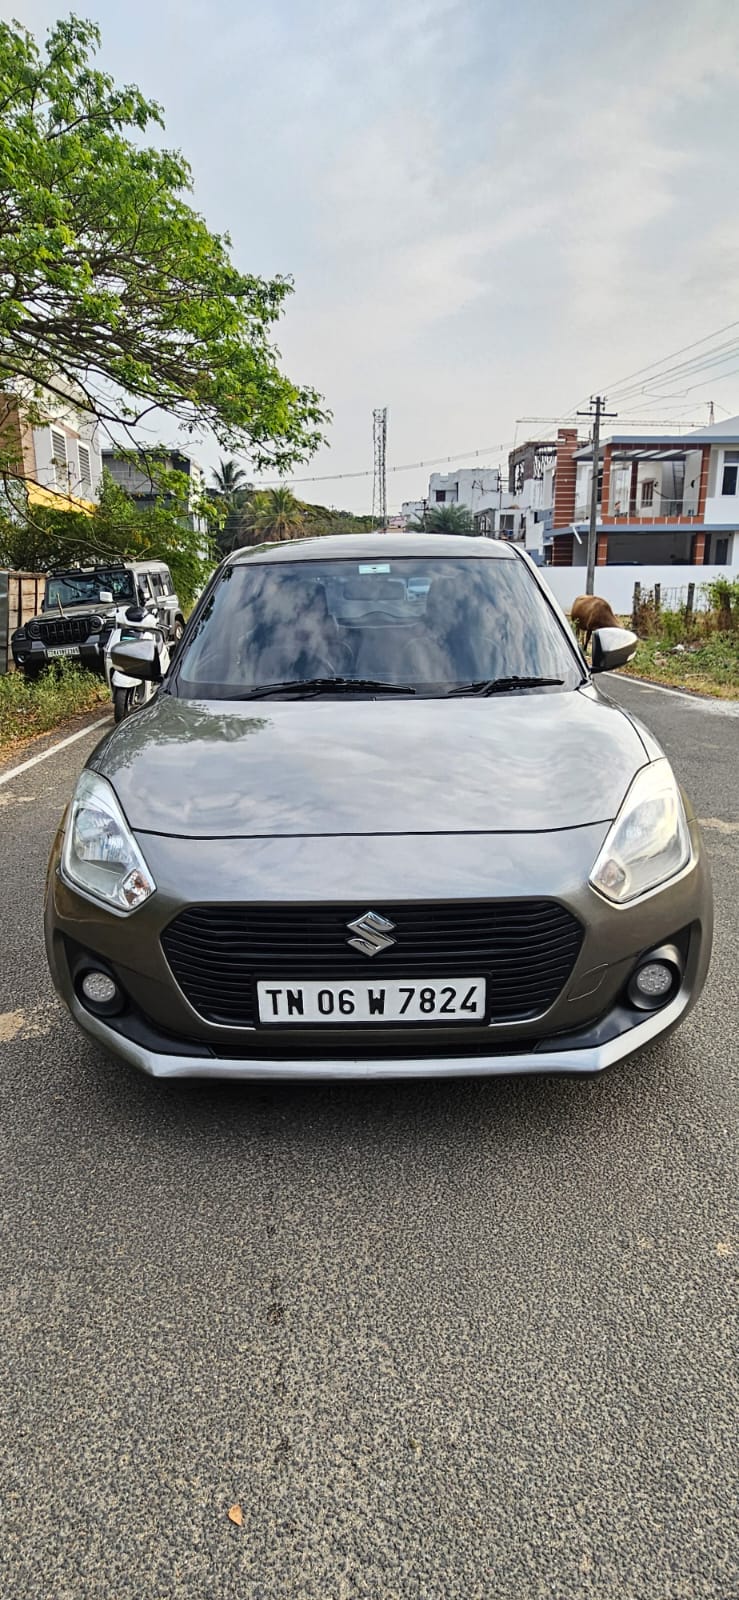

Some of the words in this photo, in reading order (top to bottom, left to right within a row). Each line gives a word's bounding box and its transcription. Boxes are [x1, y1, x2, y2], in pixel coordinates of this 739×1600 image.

[264, 988, 304, 1016] TN
[317, 989, 356, 1015] 06
[367, 988, 386, 1016] W
[398, 985, 478, 1015] 7824
